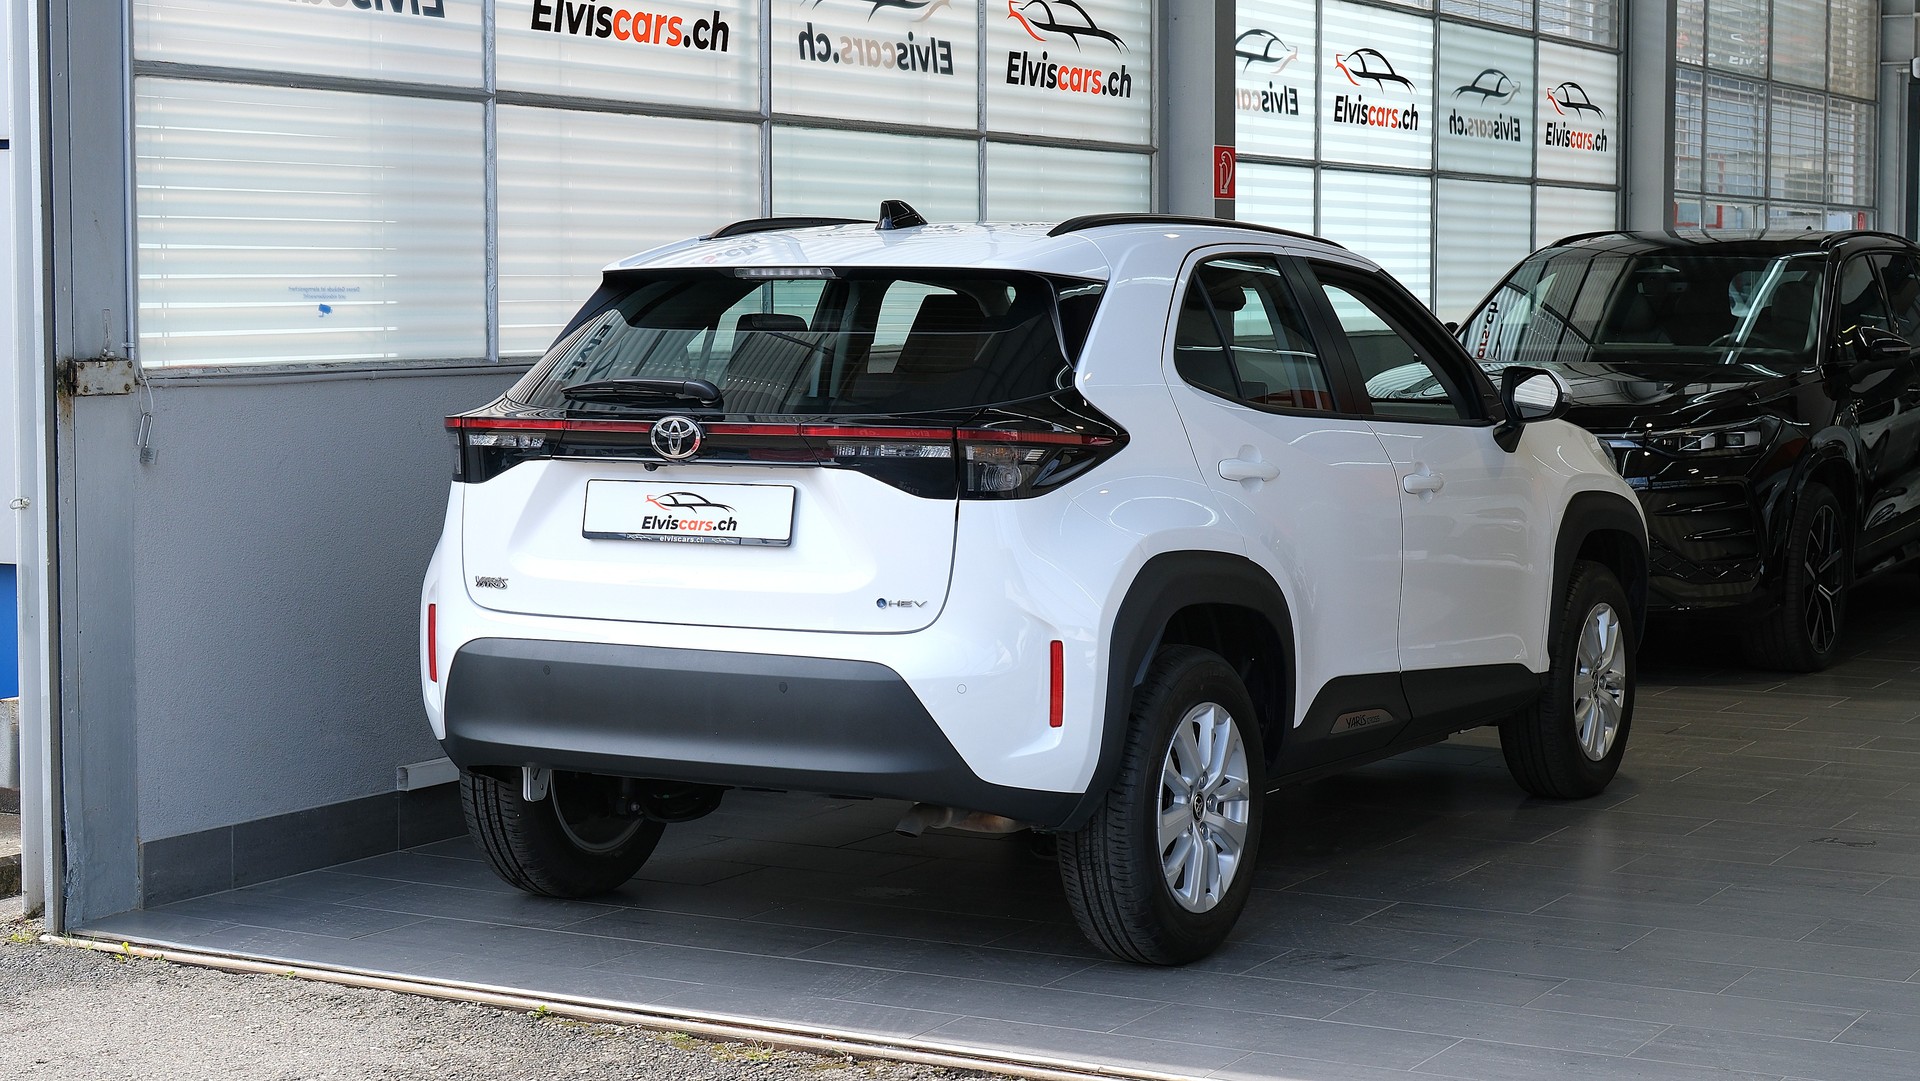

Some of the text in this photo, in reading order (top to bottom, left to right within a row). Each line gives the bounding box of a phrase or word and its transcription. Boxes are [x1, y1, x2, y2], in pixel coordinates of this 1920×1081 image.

[531, 0, 730, 52] Elviscars.ch
[1006, 51, 1132, 98] Elviscars.ch
[1333, 94, 1419, 131] Elviscars.ch
[1545, 121, 1608, 152] Elviscars.ch
[641, 514, 738, 532] Elviscars.ch
[659, 535, 705, 544] elviscars.ch
[888, 600, 928, 608] HEV
